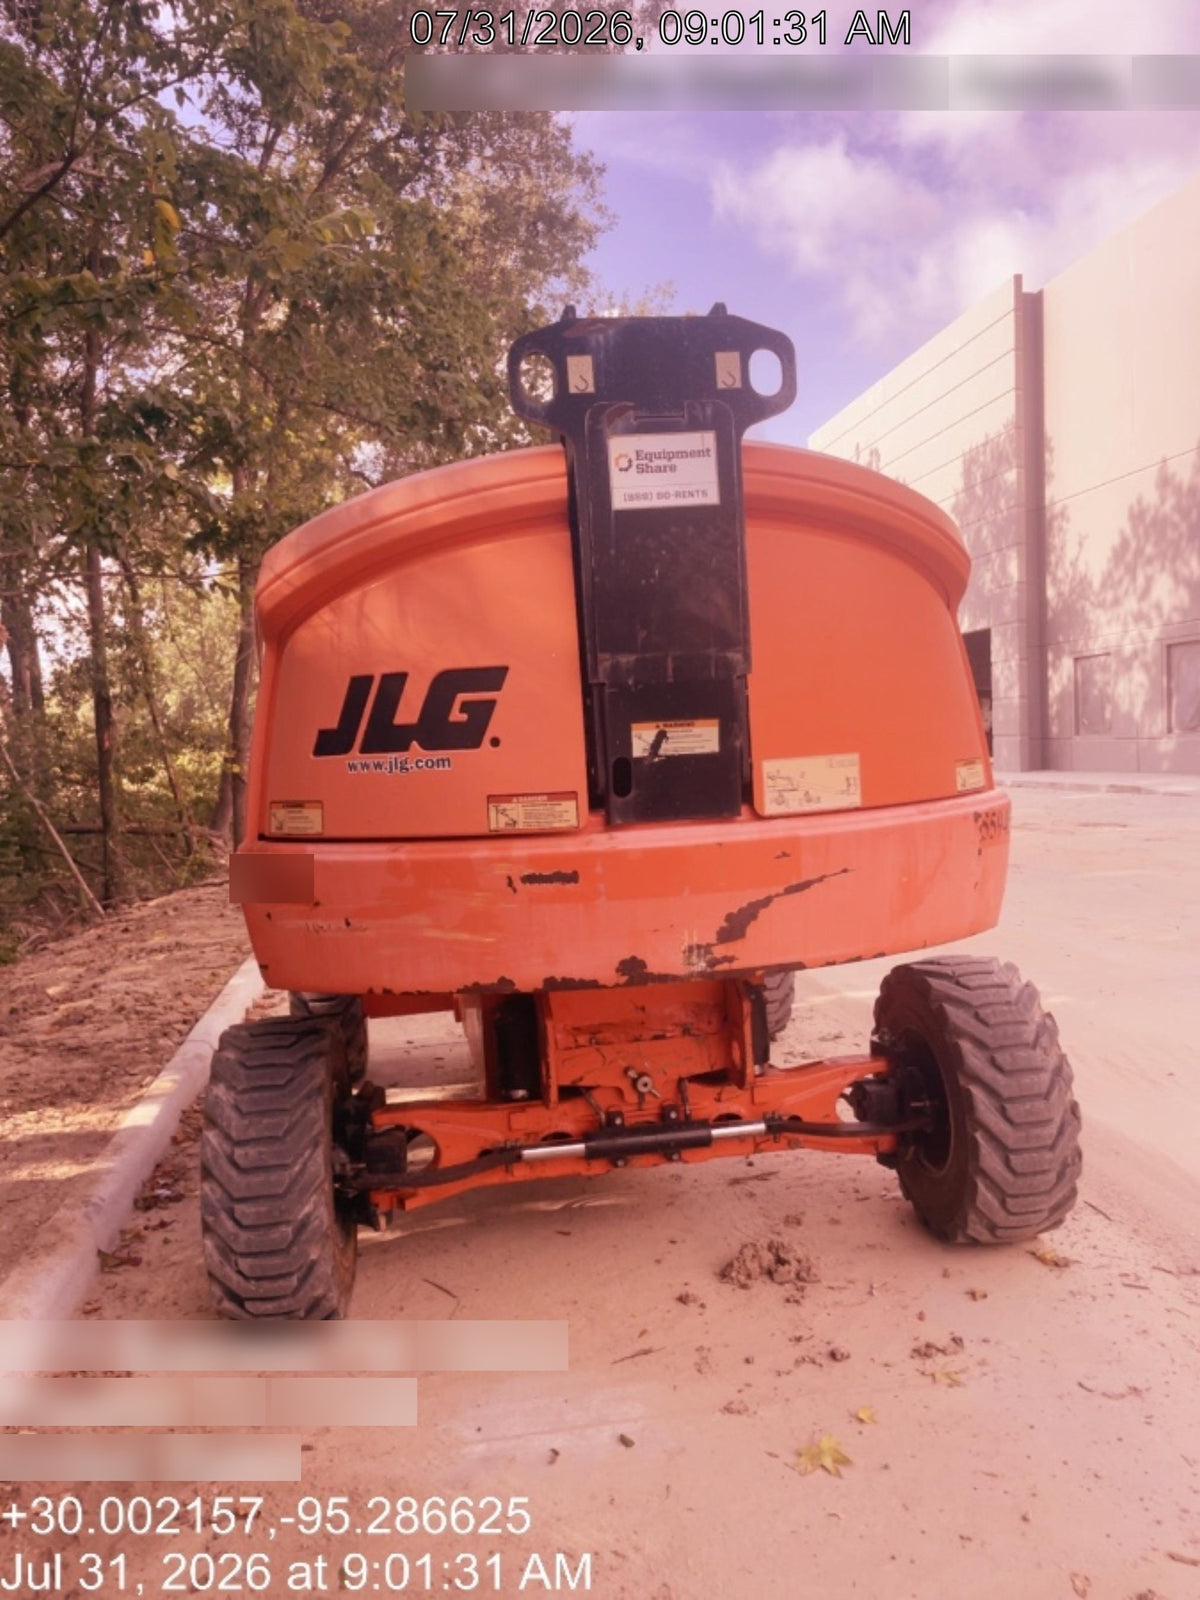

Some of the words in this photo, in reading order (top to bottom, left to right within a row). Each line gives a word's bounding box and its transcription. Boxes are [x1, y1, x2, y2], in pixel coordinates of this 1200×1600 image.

[635, 448, 711, 462] Equipment
[635, 463, 678, 474] Share
[347, 756, 452, 774] www.jlg.com
